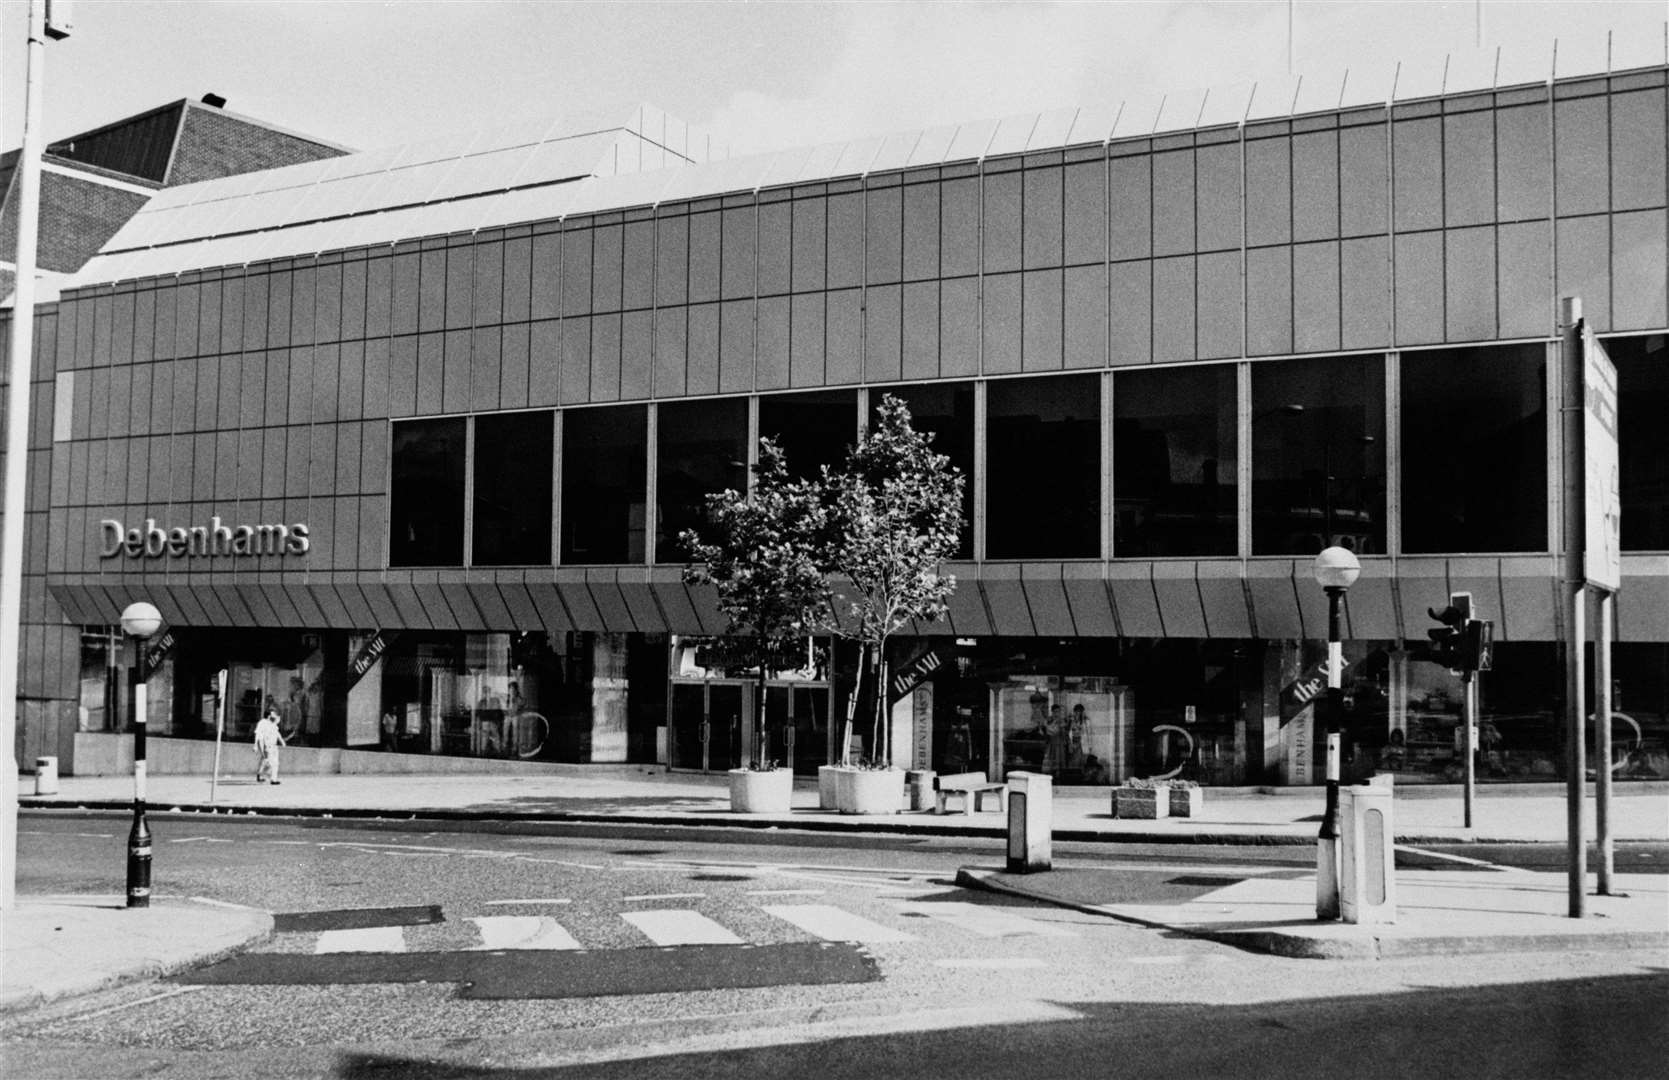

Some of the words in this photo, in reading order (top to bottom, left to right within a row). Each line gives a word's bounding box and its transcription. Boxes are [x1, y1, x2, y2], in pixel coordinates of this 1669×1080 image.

[101, 516, 309, 558] Debenhams
[355, 656, 370, 674] the
[894, 672, 917, 694] the
[1294, 678, 1323, 703] the
